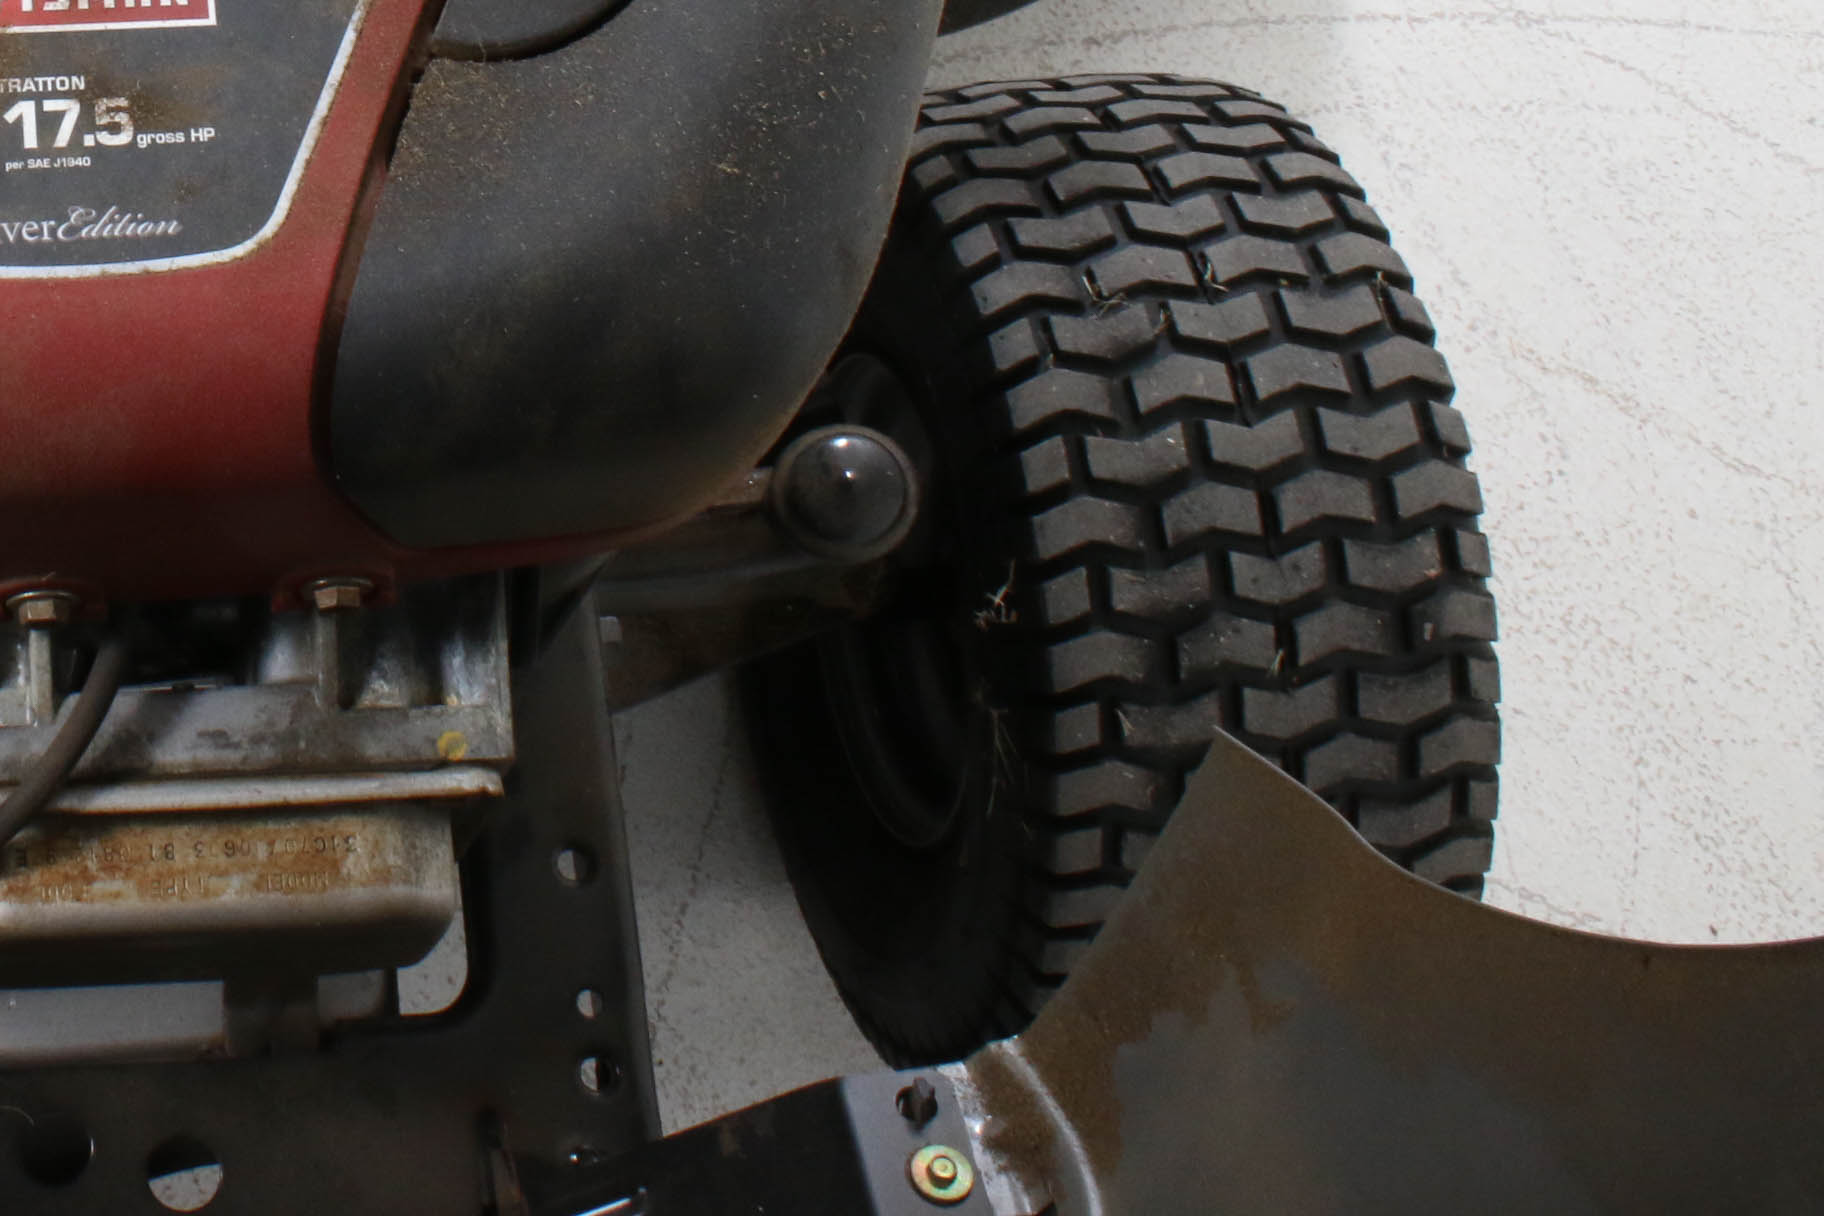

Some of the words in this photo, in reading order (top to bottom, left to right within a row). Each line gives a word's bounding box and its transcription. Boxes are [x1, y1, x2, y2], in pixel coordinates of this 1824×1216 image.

[2, 96, 134, 150] 17.5
[136, 131, 186, 149] gross
[190, 127, 217, 144] HP
[5, 161, 26, 173] per
[27, 158, 52, 170] SAE
